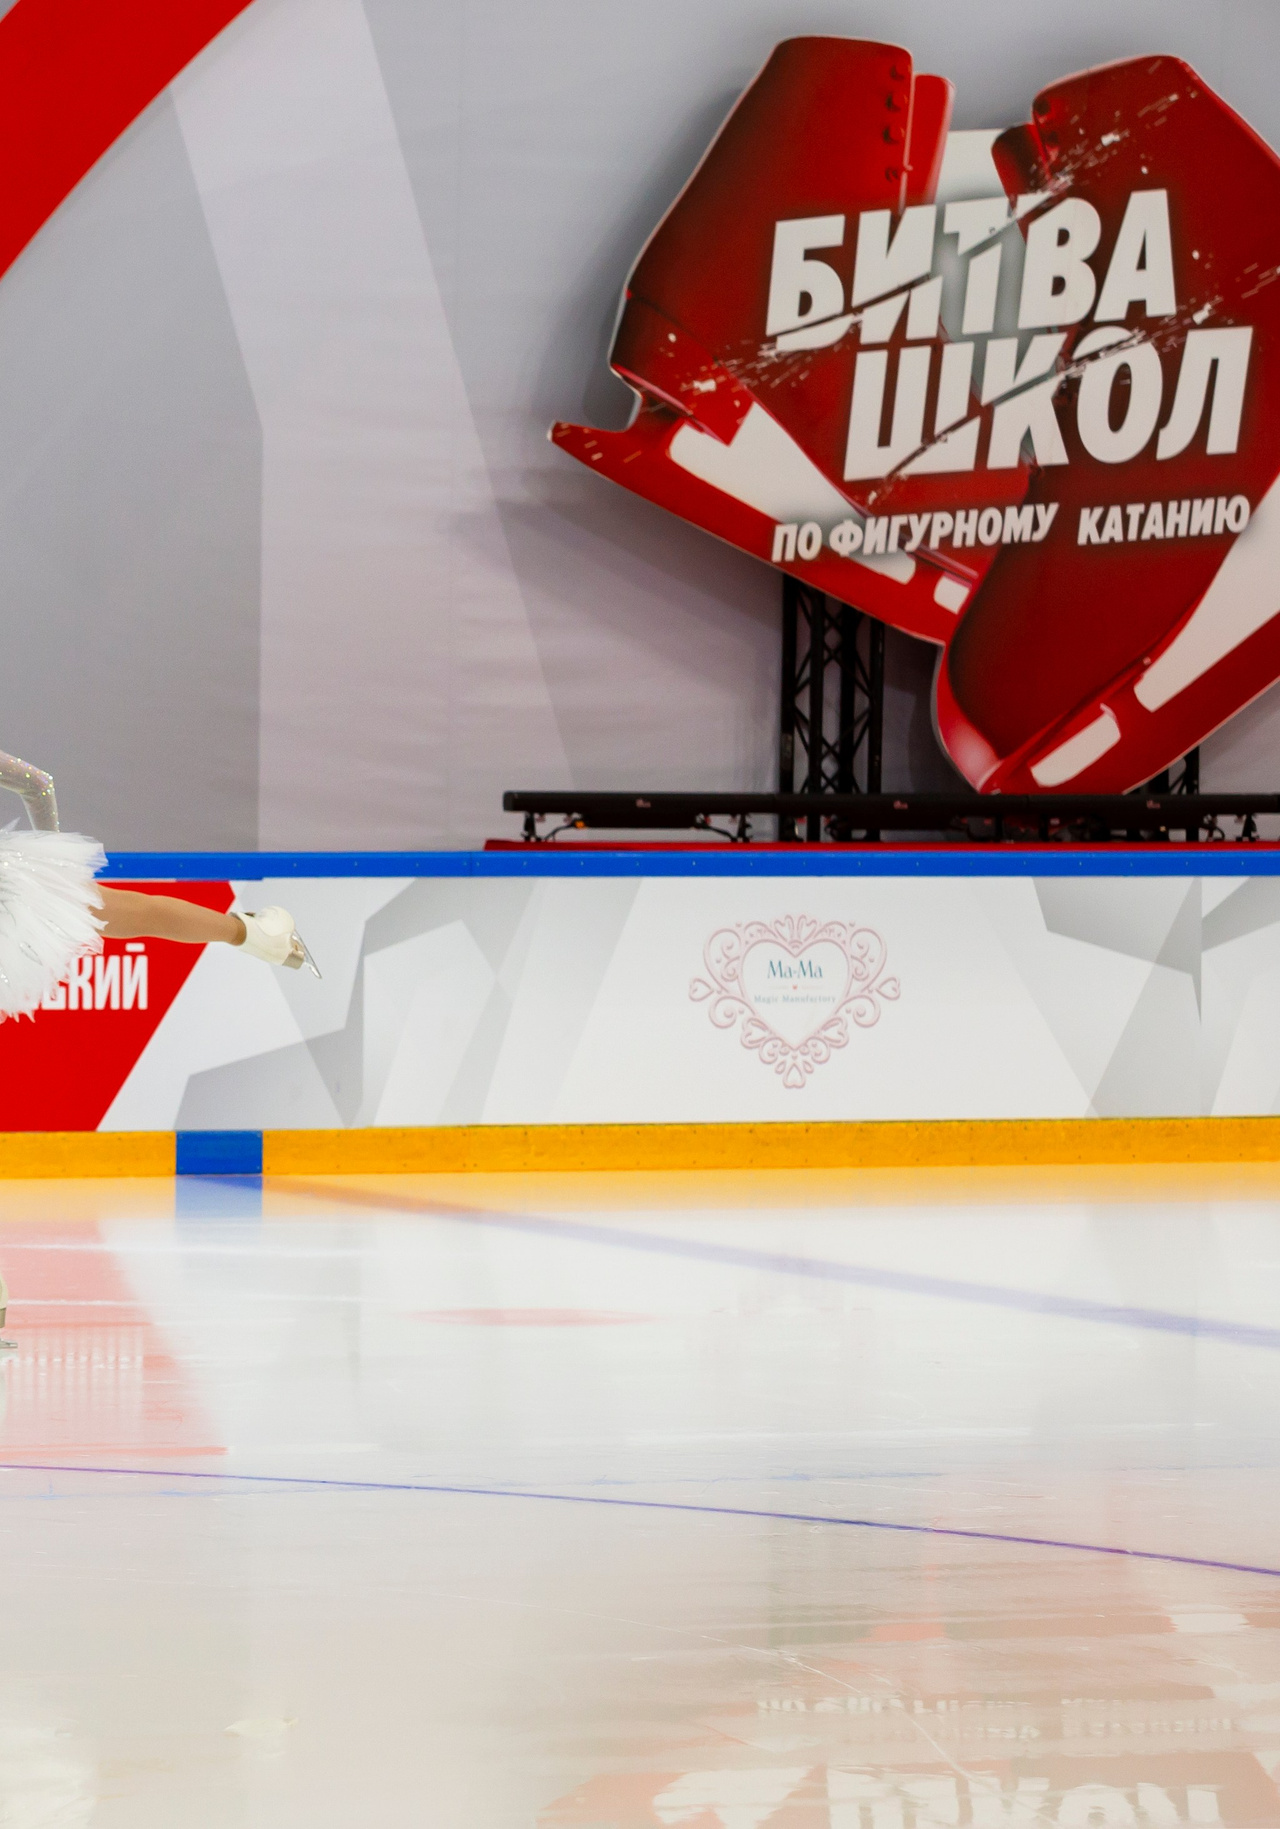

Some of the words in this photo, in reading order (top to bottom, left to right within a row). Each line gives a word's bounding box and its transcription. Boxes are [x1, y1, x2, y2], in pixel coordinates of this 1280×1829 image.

[766, 189, 1176, 352] БИТВА
[844, 326, 1253, 481] ШКОЛ
[772, 523, 823, 562] ПО
[829, 502, 1059, 557] ФИГУРНОМУ
[1077, 495, 1251, 545] КАТАНИЮ
